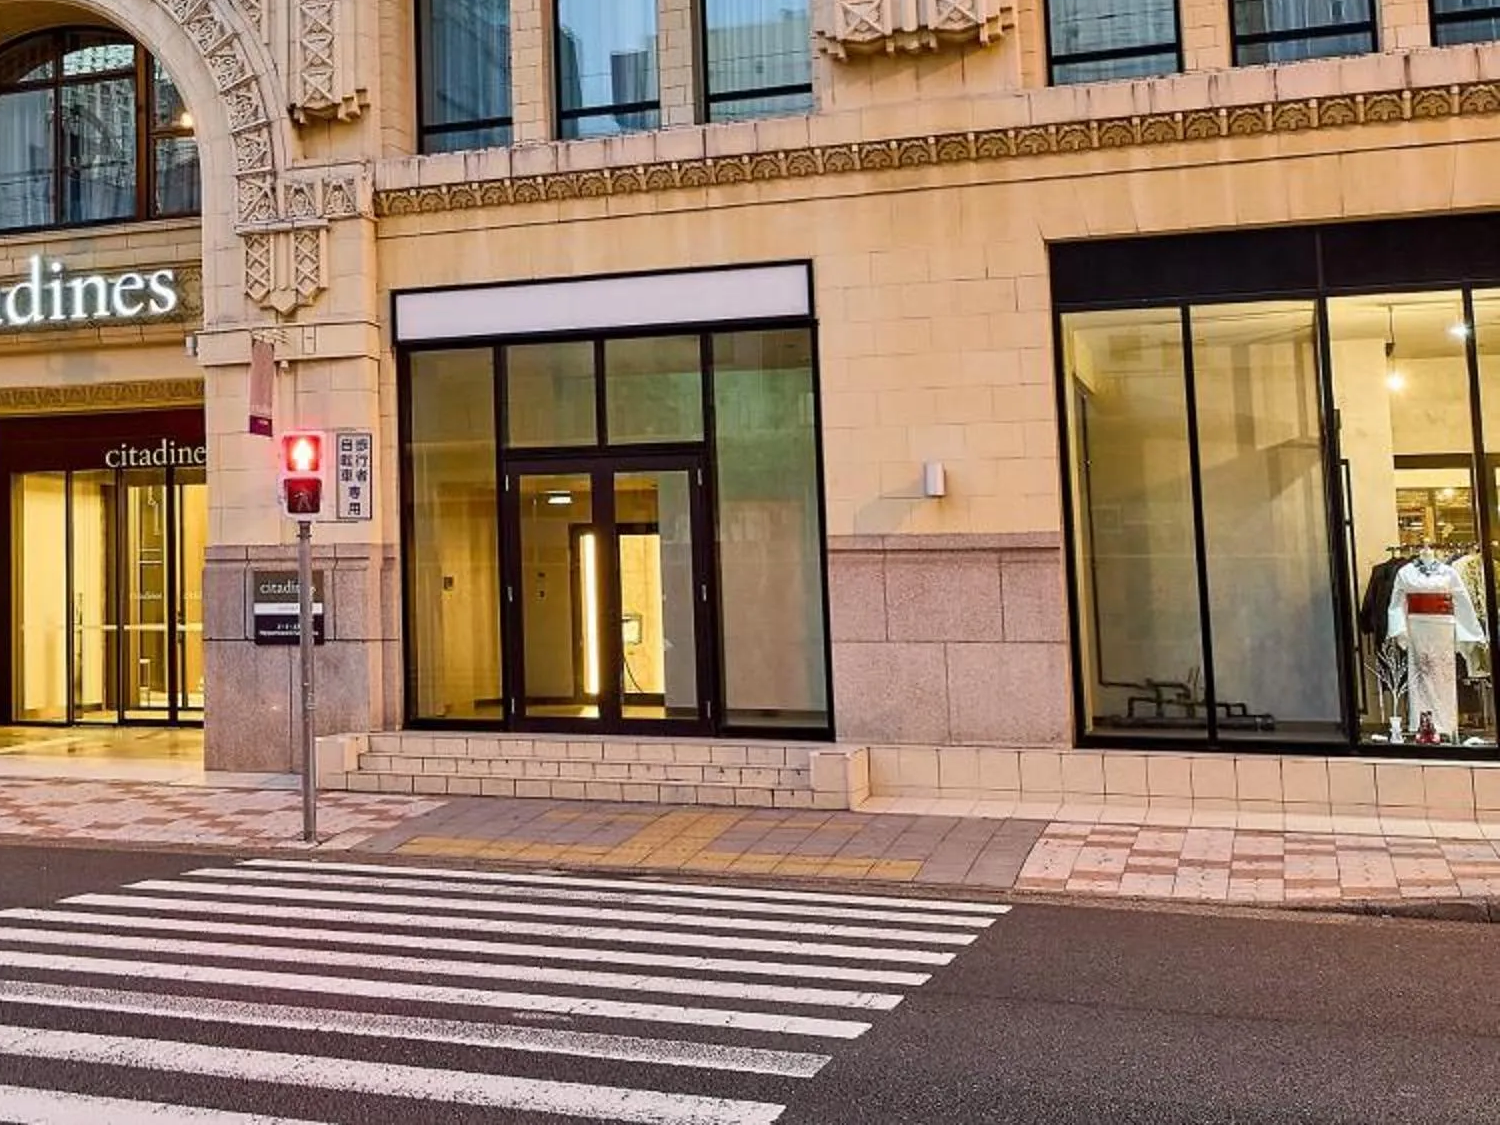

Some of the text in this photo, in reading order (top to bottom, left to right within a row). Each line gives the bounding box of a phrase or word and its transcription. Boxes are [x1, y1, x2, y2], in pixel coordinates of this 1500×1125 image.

[105, 438, 206, 468] citadine
[348, 485, 360, 515] 専用
[260, 578, 317, 594] citadis
